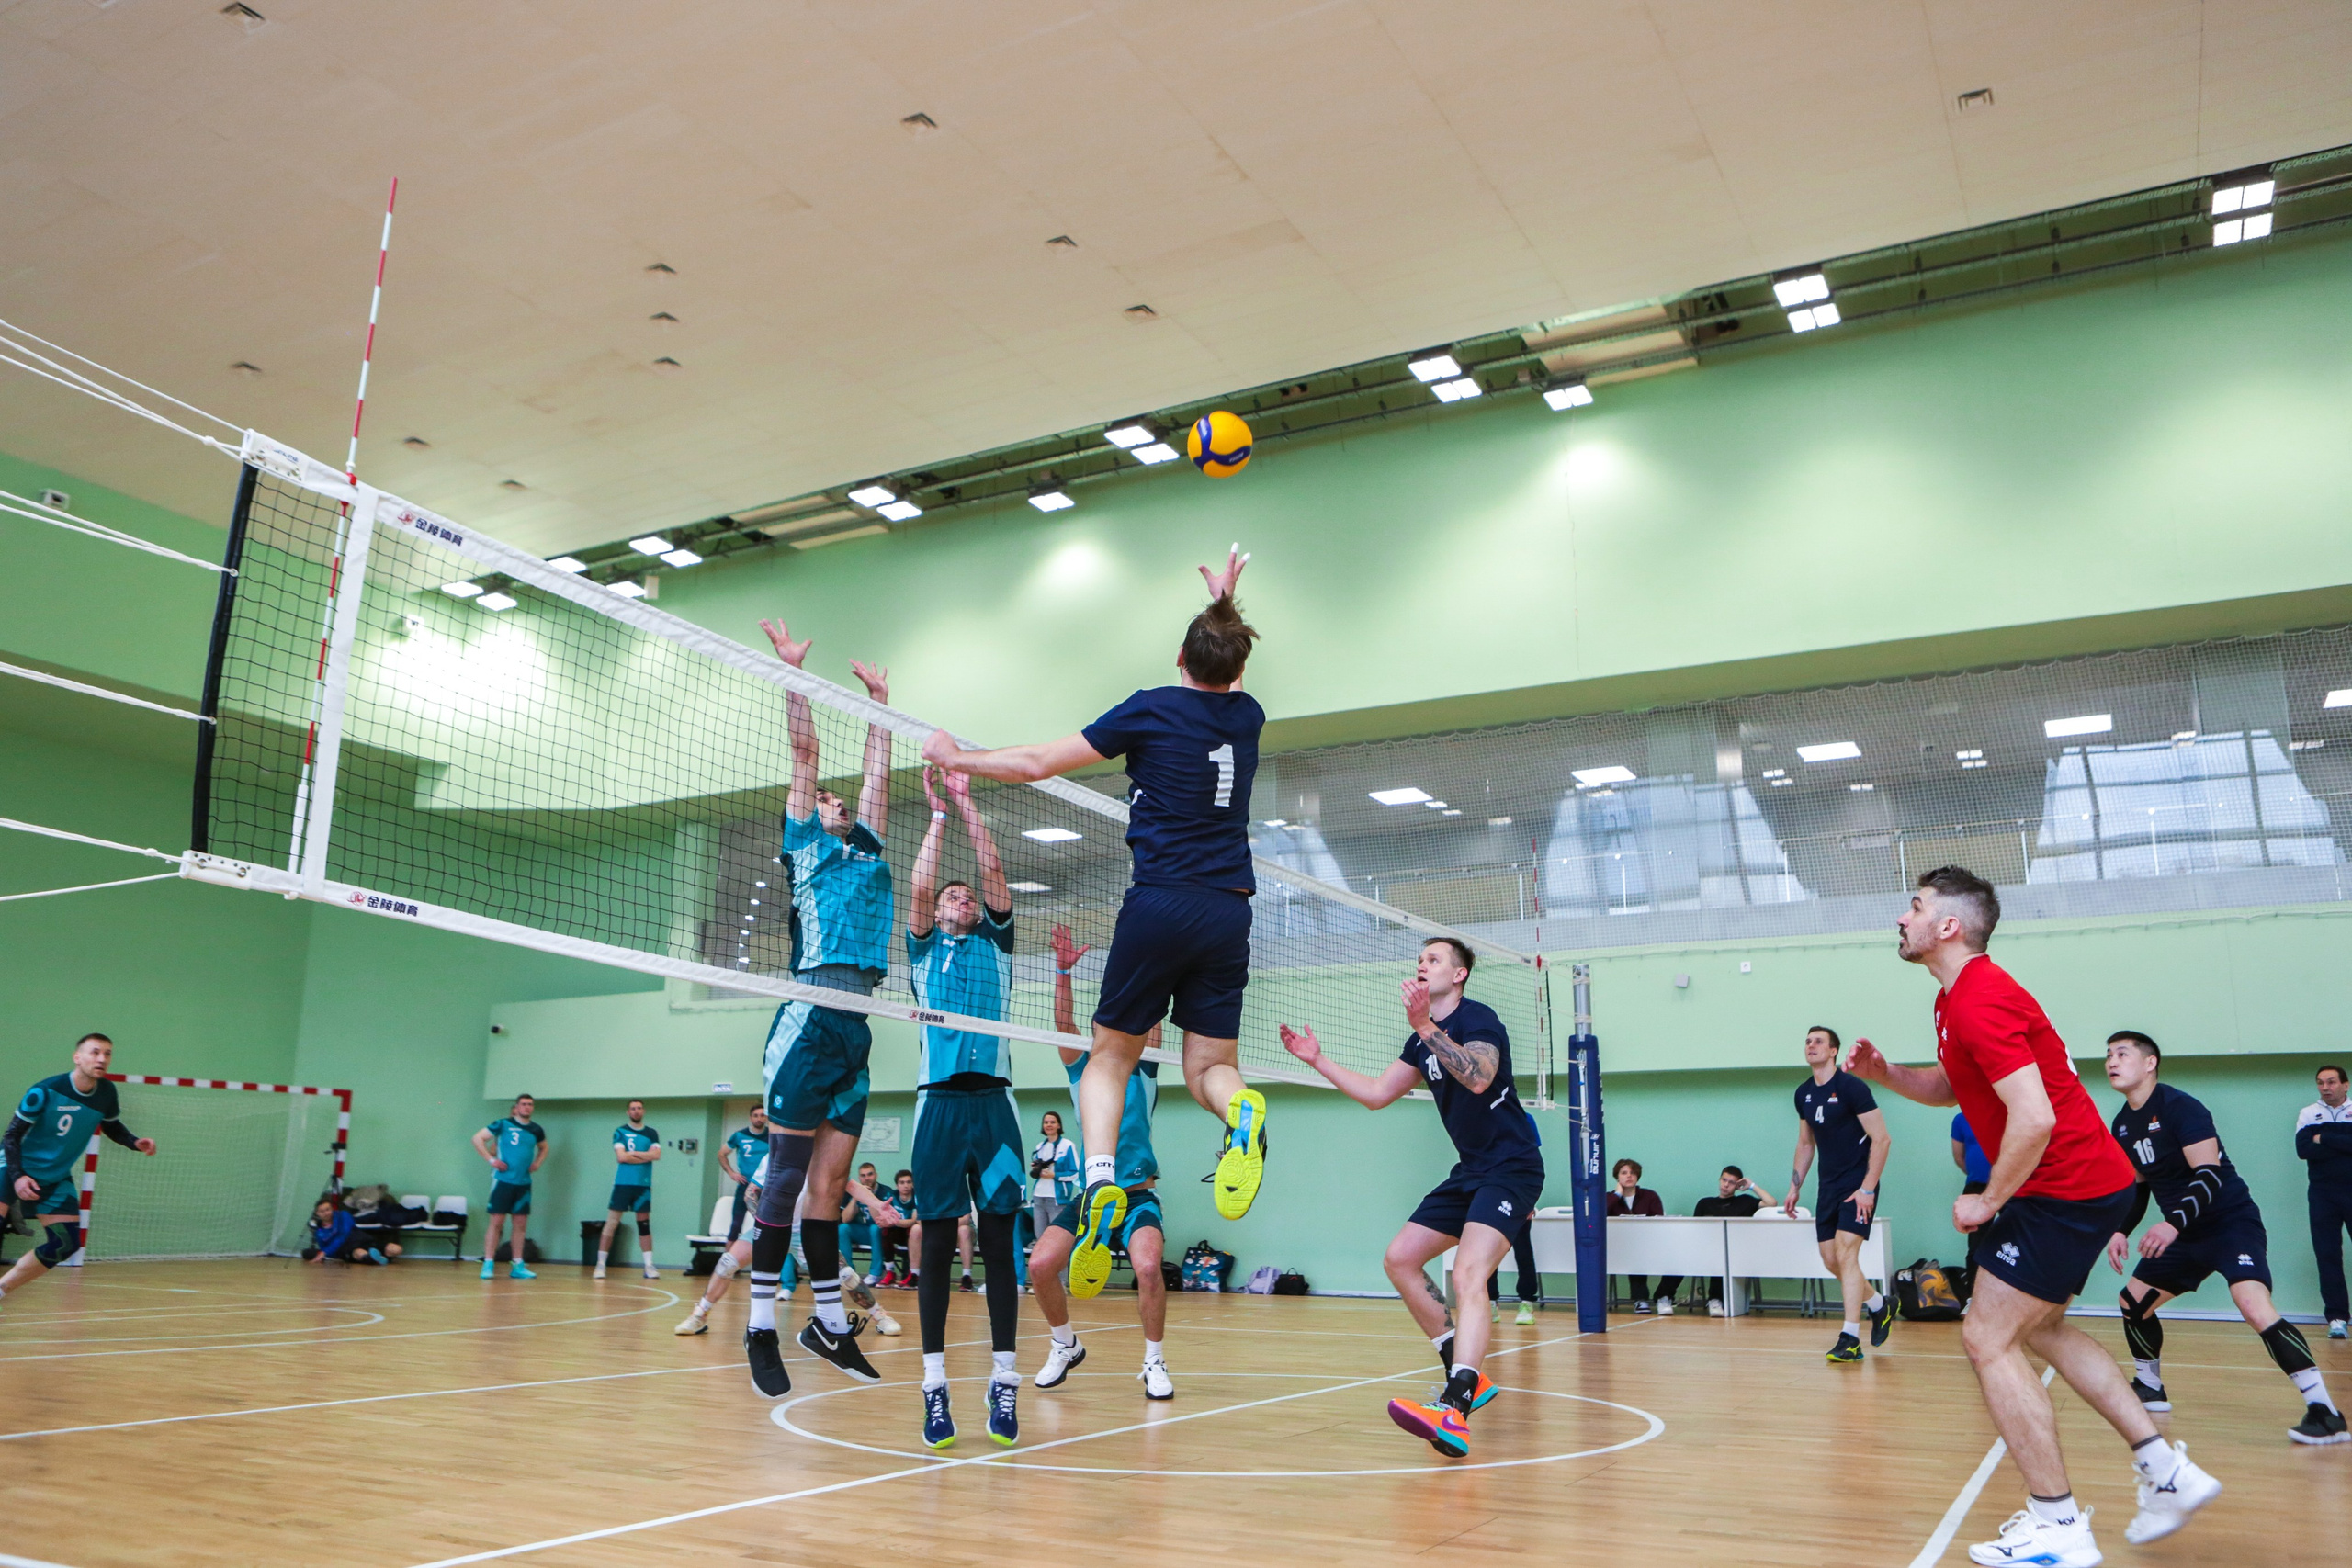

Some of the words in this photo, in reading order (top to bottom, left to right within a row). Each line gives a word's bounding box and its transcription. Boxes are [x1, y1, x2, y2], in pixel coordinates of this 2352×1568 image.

[1208, 743, 1234, 807] 1
[368, 896, 418, 917] 金陵体育
[1815, 1105, 1825, 1124] 4
[56, 1113, 73, 1137] 9
[510, 1132, 520, 1145] 3
[627, 1138, 636, 1152] 6
[742, 1144, 752, 1157] 2
[2133, 1137, 2155, 1165] 16
